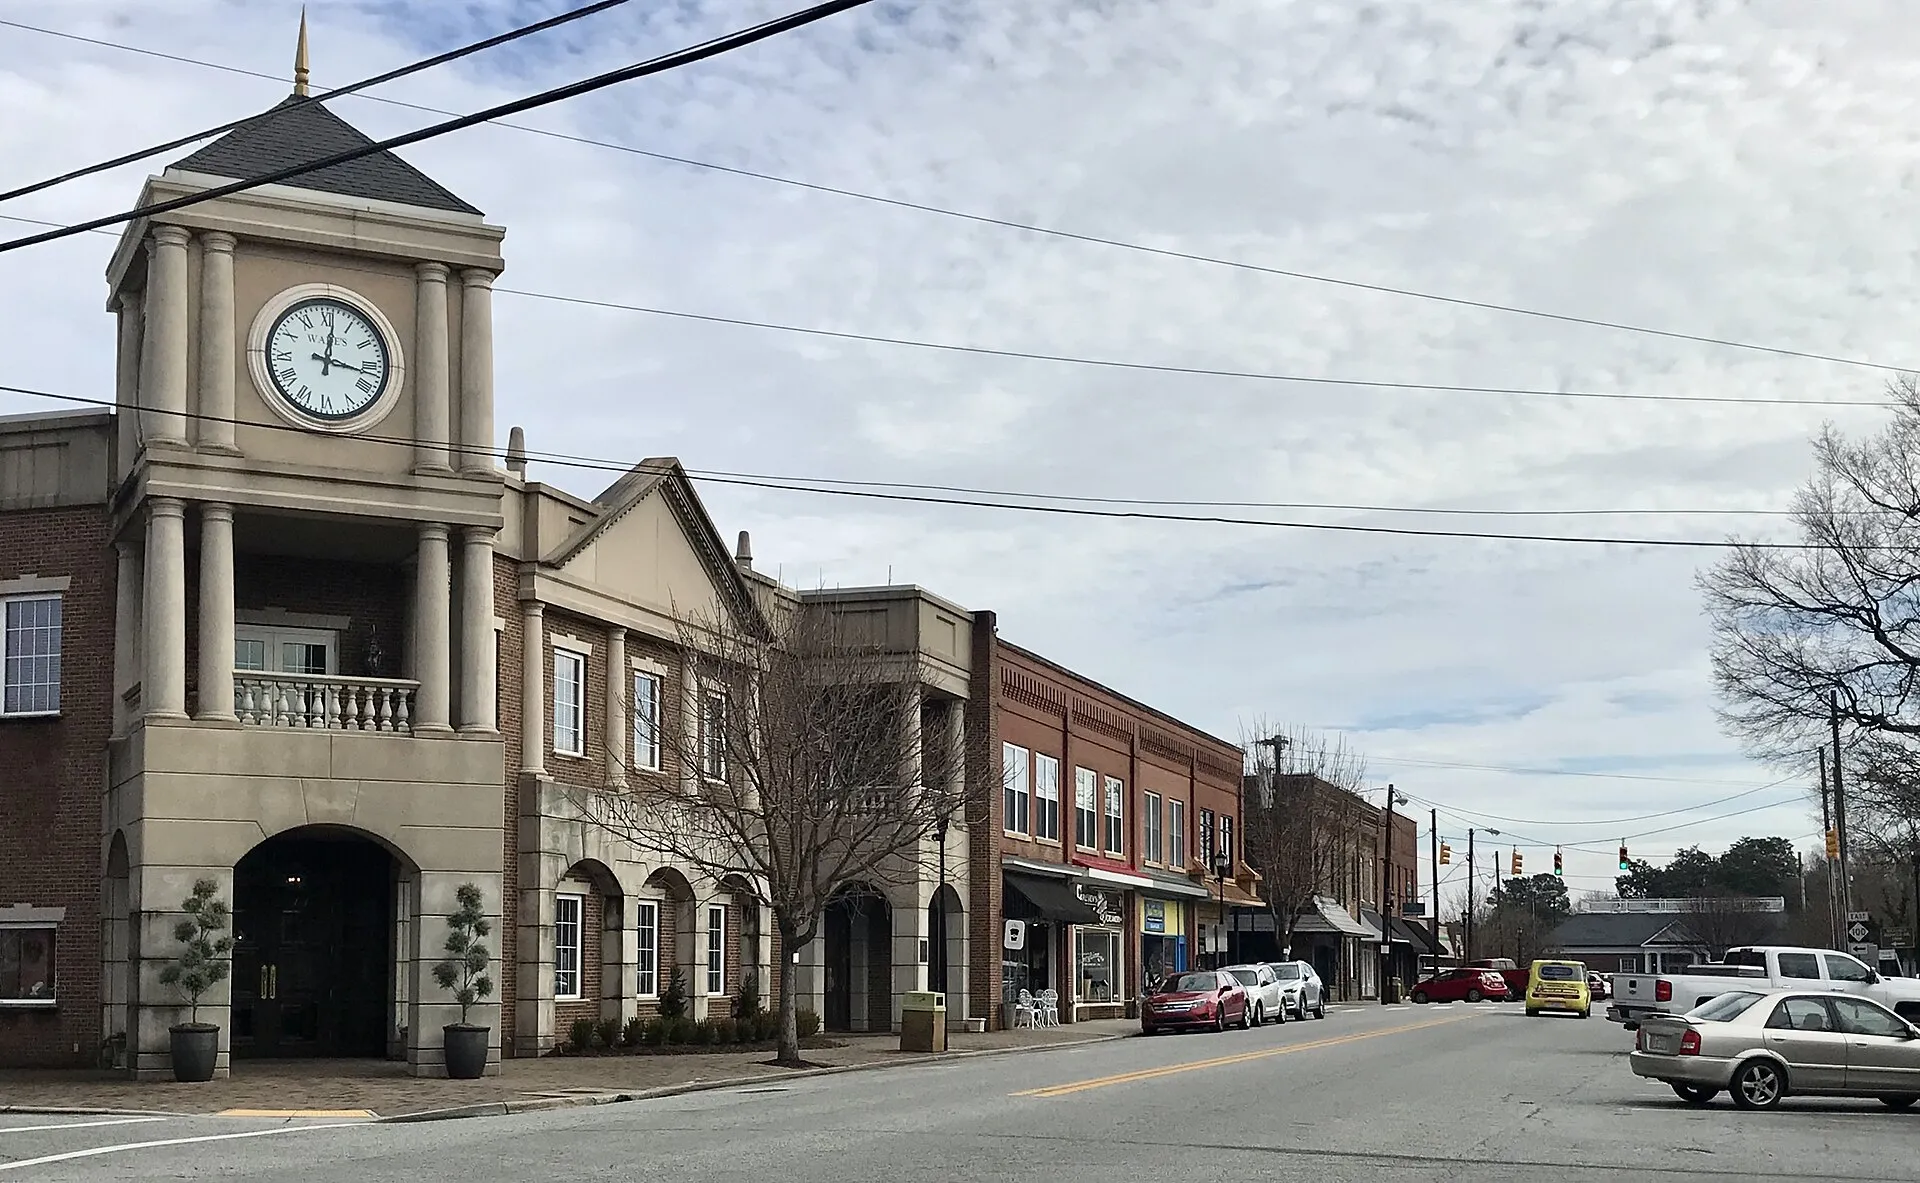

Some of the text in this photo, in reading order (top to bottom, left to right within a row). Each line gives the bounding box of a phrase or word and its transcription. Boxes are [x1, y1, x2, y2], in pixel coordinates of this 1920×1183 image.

[282, 328, 298, 342] X
[307, 334, 347, 346] WAE'S
[345, 393, 355, 407] V
[1851, 927, 1867, 937] 100
